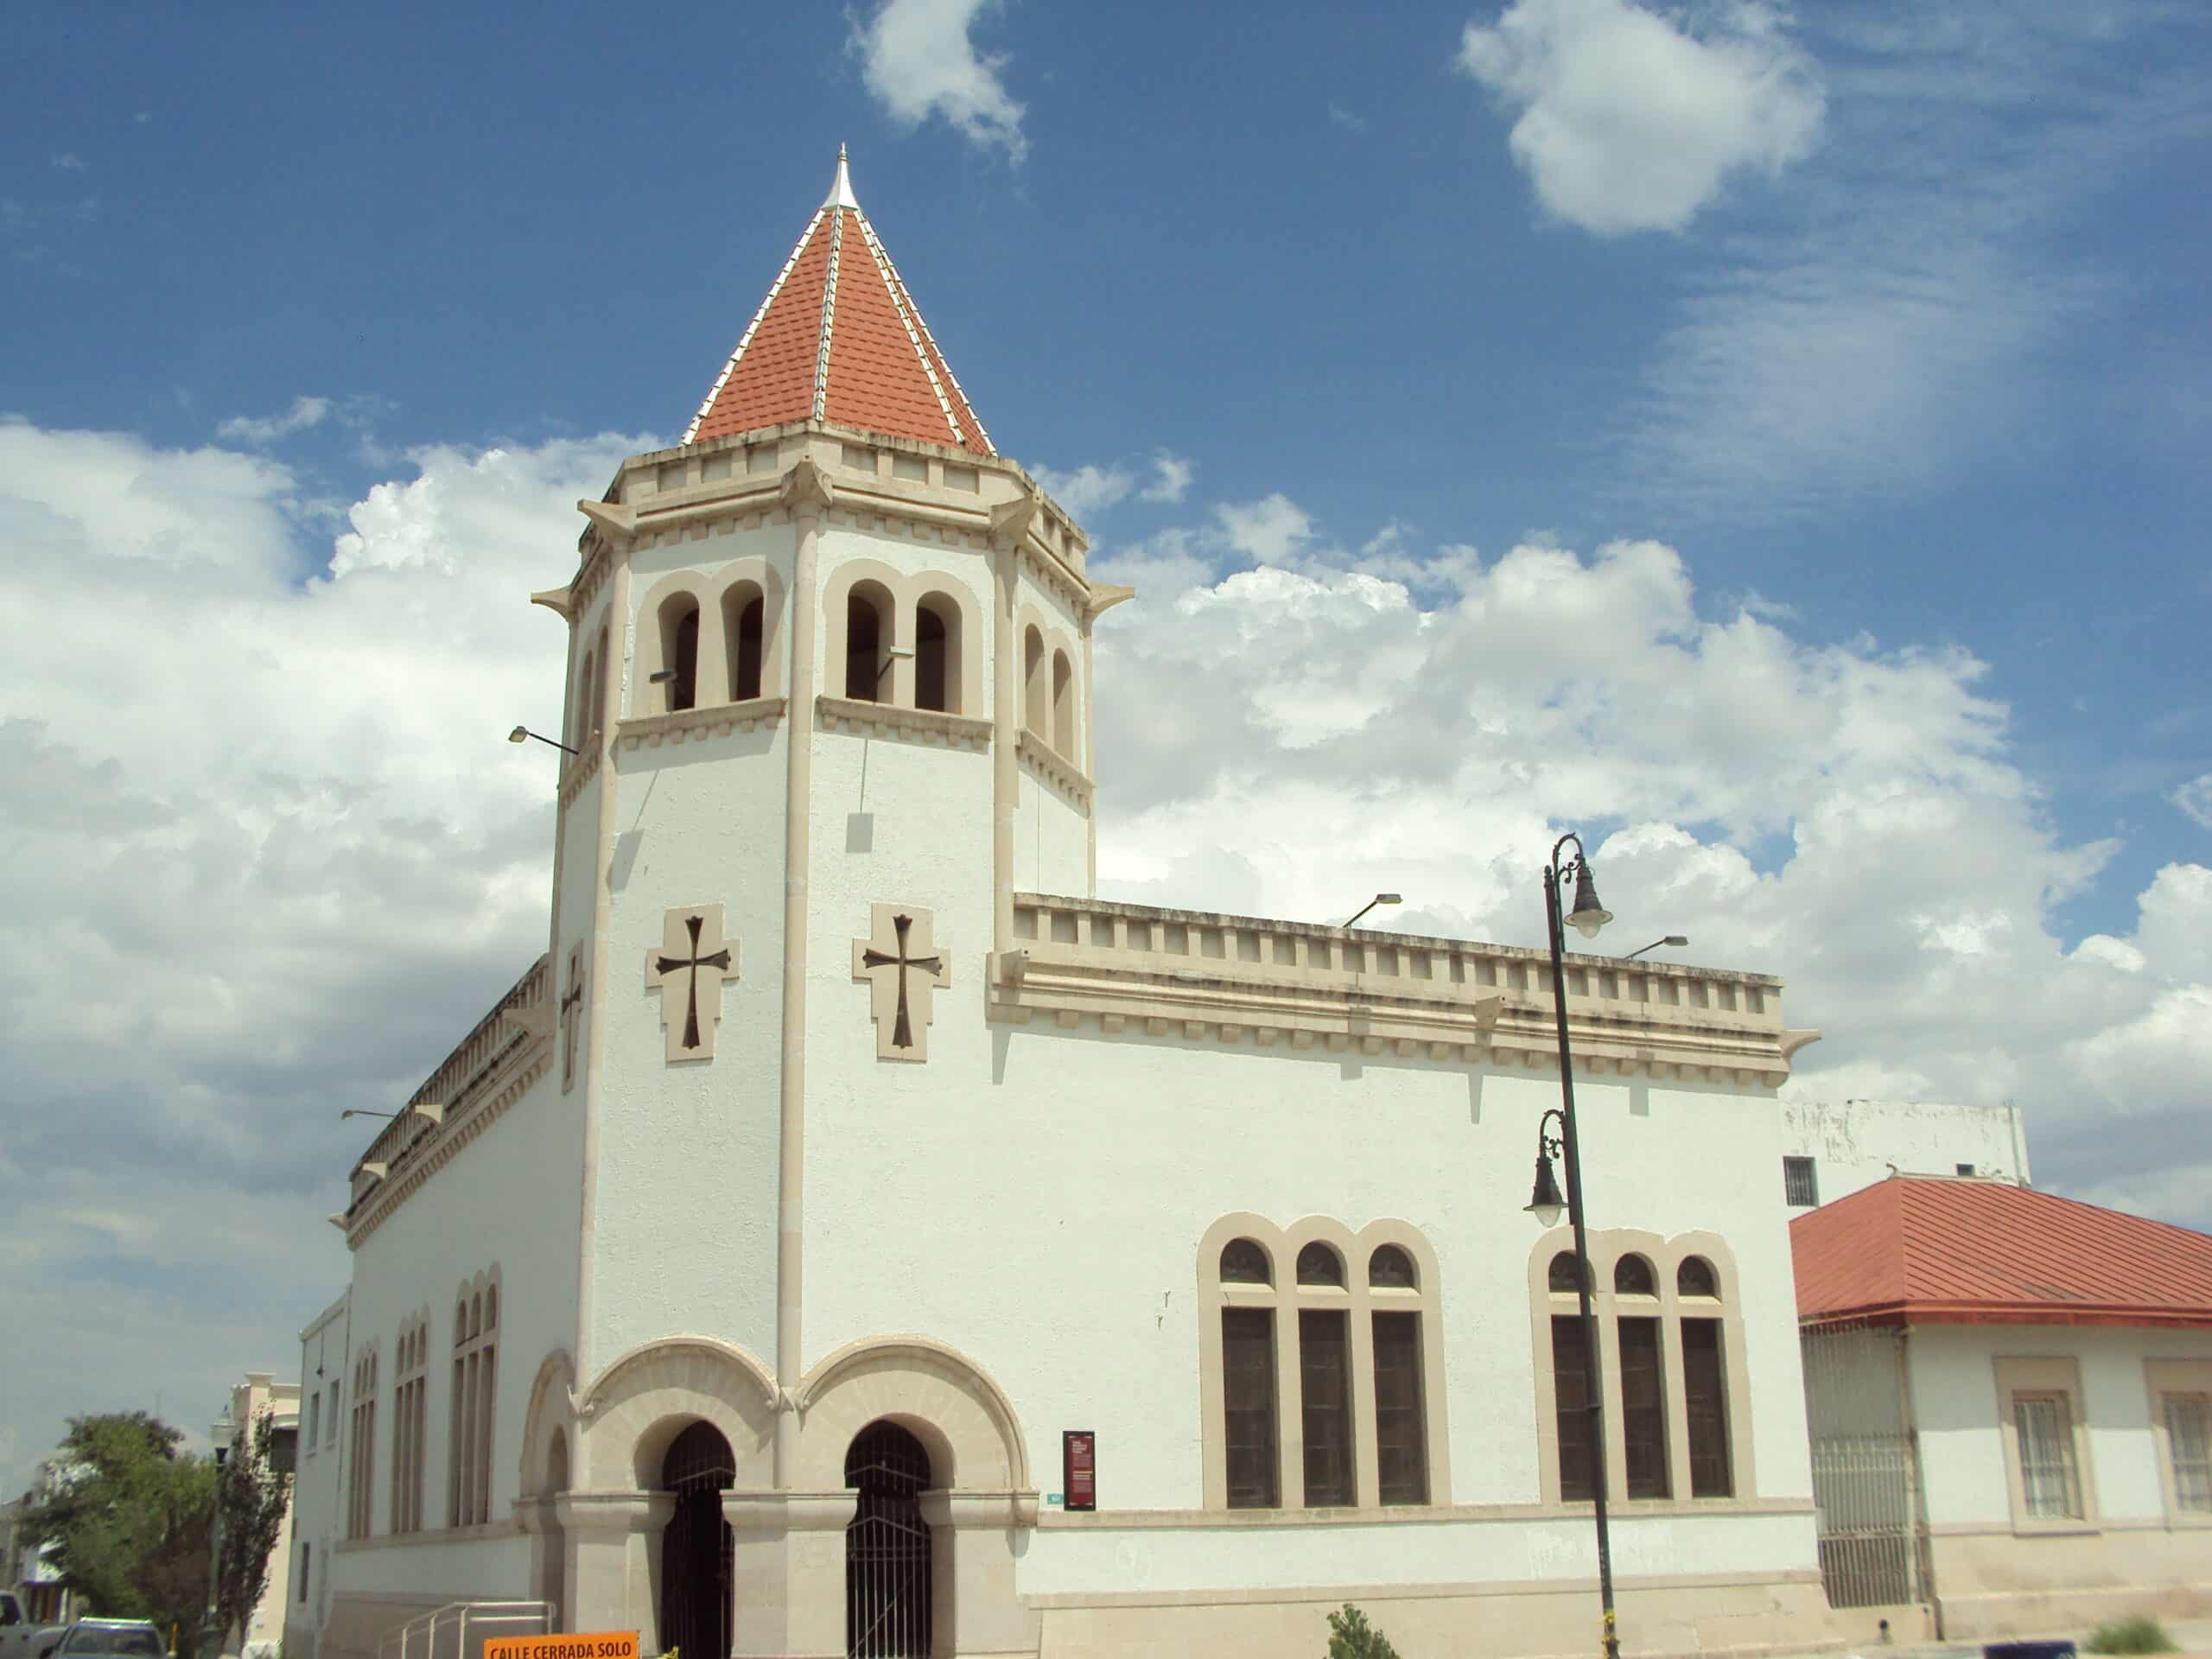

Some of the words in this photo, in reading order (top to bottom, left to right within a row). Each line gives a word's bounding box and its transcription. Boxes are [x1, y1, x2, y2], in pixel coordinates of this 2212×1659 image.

[490, 1646, 530, 1659] CALLE
[533, 1643, 594, 1659] CERRADA
[598, 1642, 632, 1658] SOLO
